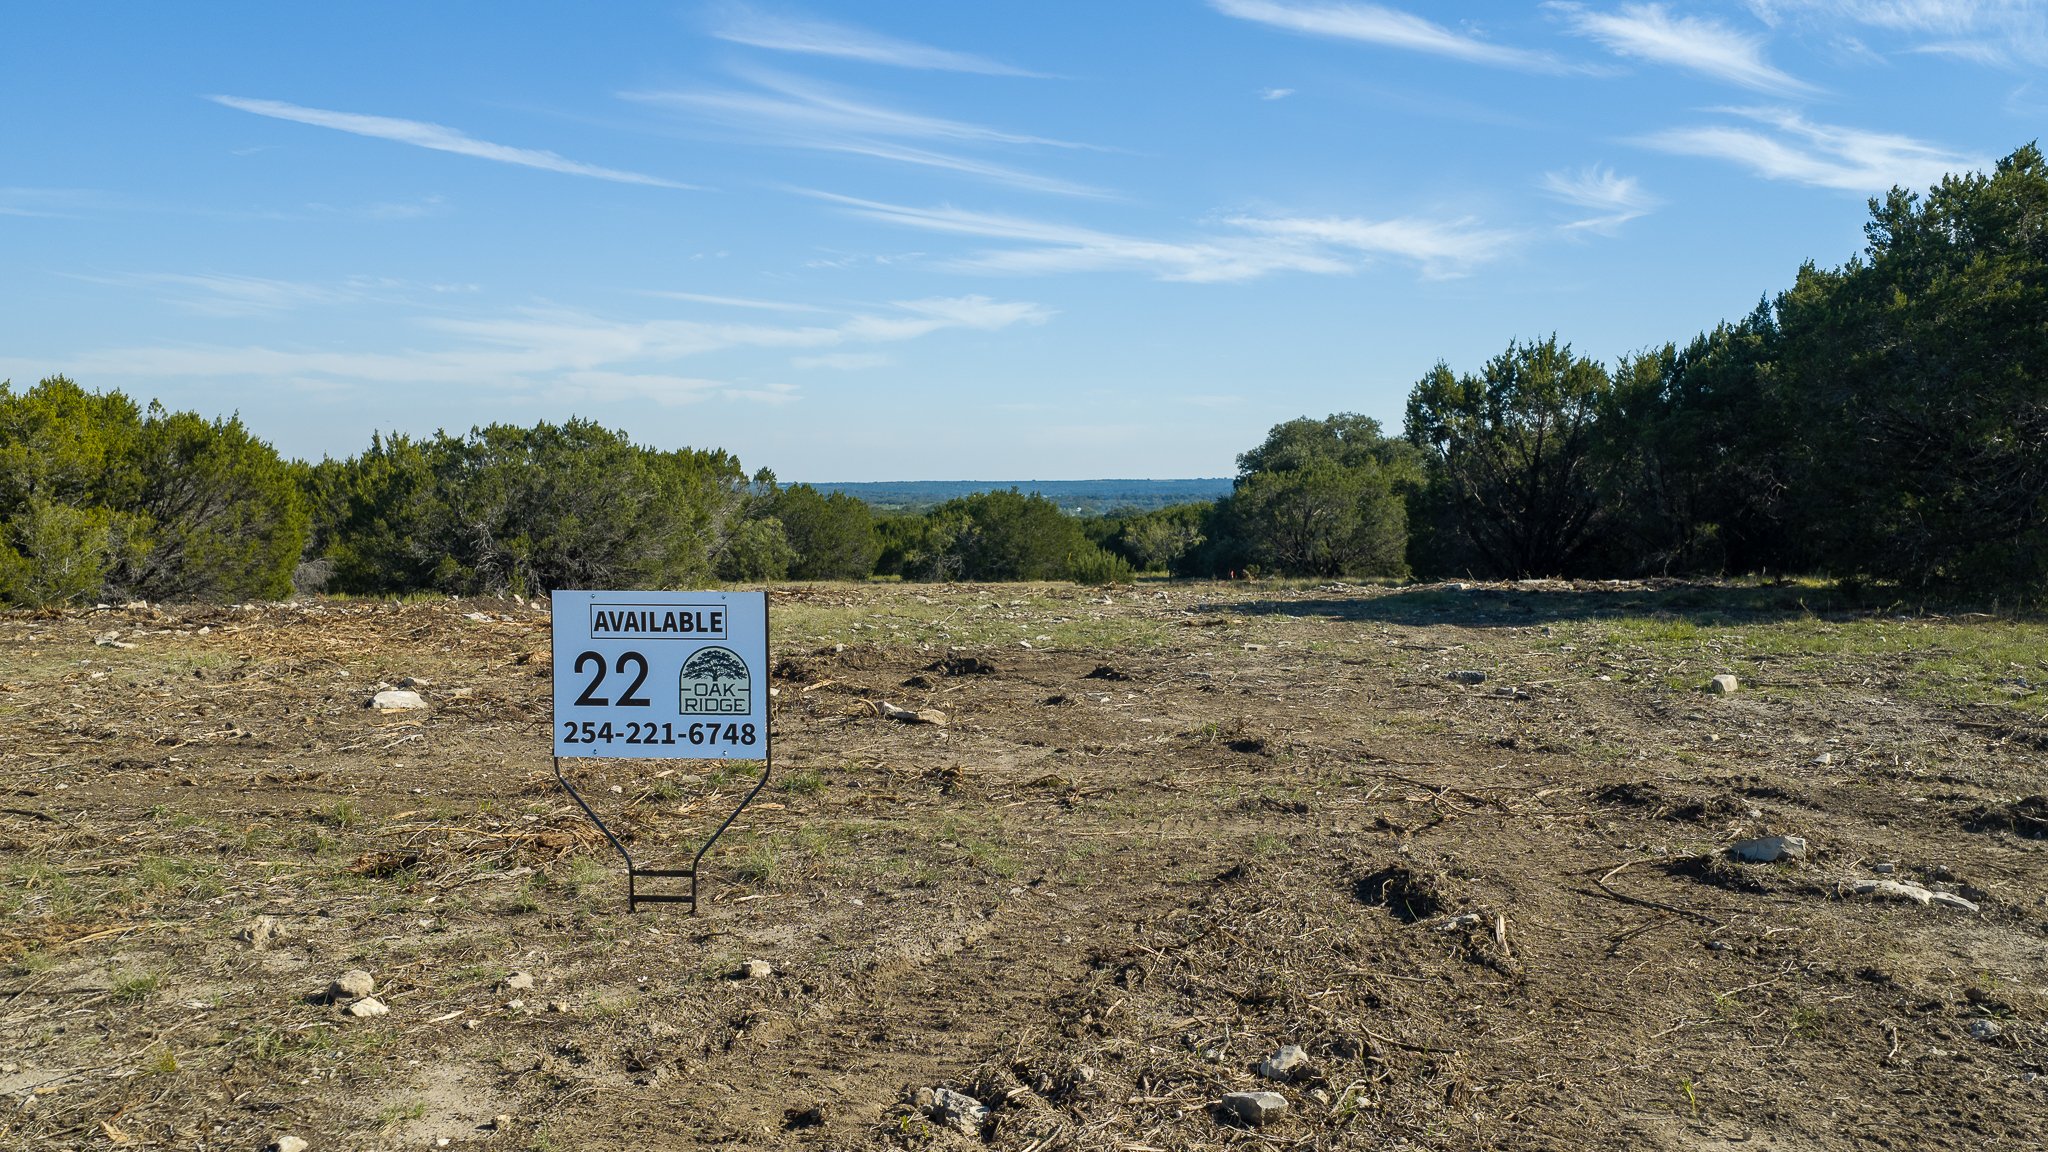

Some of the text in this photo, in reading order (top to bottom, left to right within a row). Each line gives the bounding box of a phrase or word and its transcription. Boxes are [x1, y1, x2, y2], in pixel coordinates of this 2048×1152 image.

[593, 611, 723, 633] AVAILABLE
[574, 650, 651, 706] 22
[694, 683, 736, 697] OAK
[684, 698, 746, 712] RIDGE
[563, 721, 756, 745] 254-221-6748
